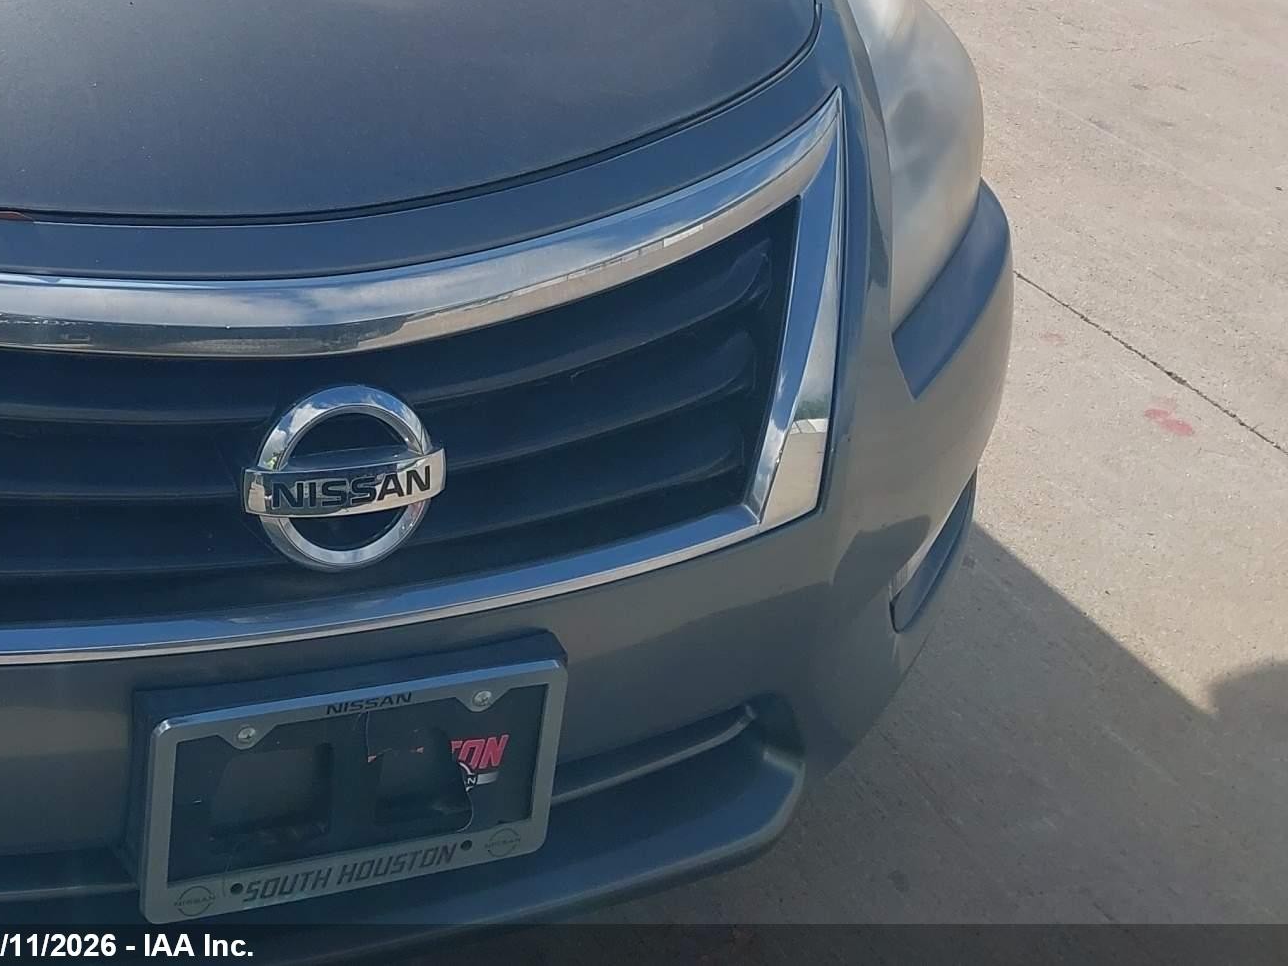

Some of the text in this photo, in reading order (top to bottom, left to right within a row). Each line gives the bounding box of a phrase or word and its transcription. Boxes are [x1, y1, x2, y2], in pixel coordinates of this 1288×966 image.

[272, 465, 431, 509] NISSAN
[326, 692, 412, 715] NISSAN
[243, 842, 458, 902] SOUTH HOUSTON
